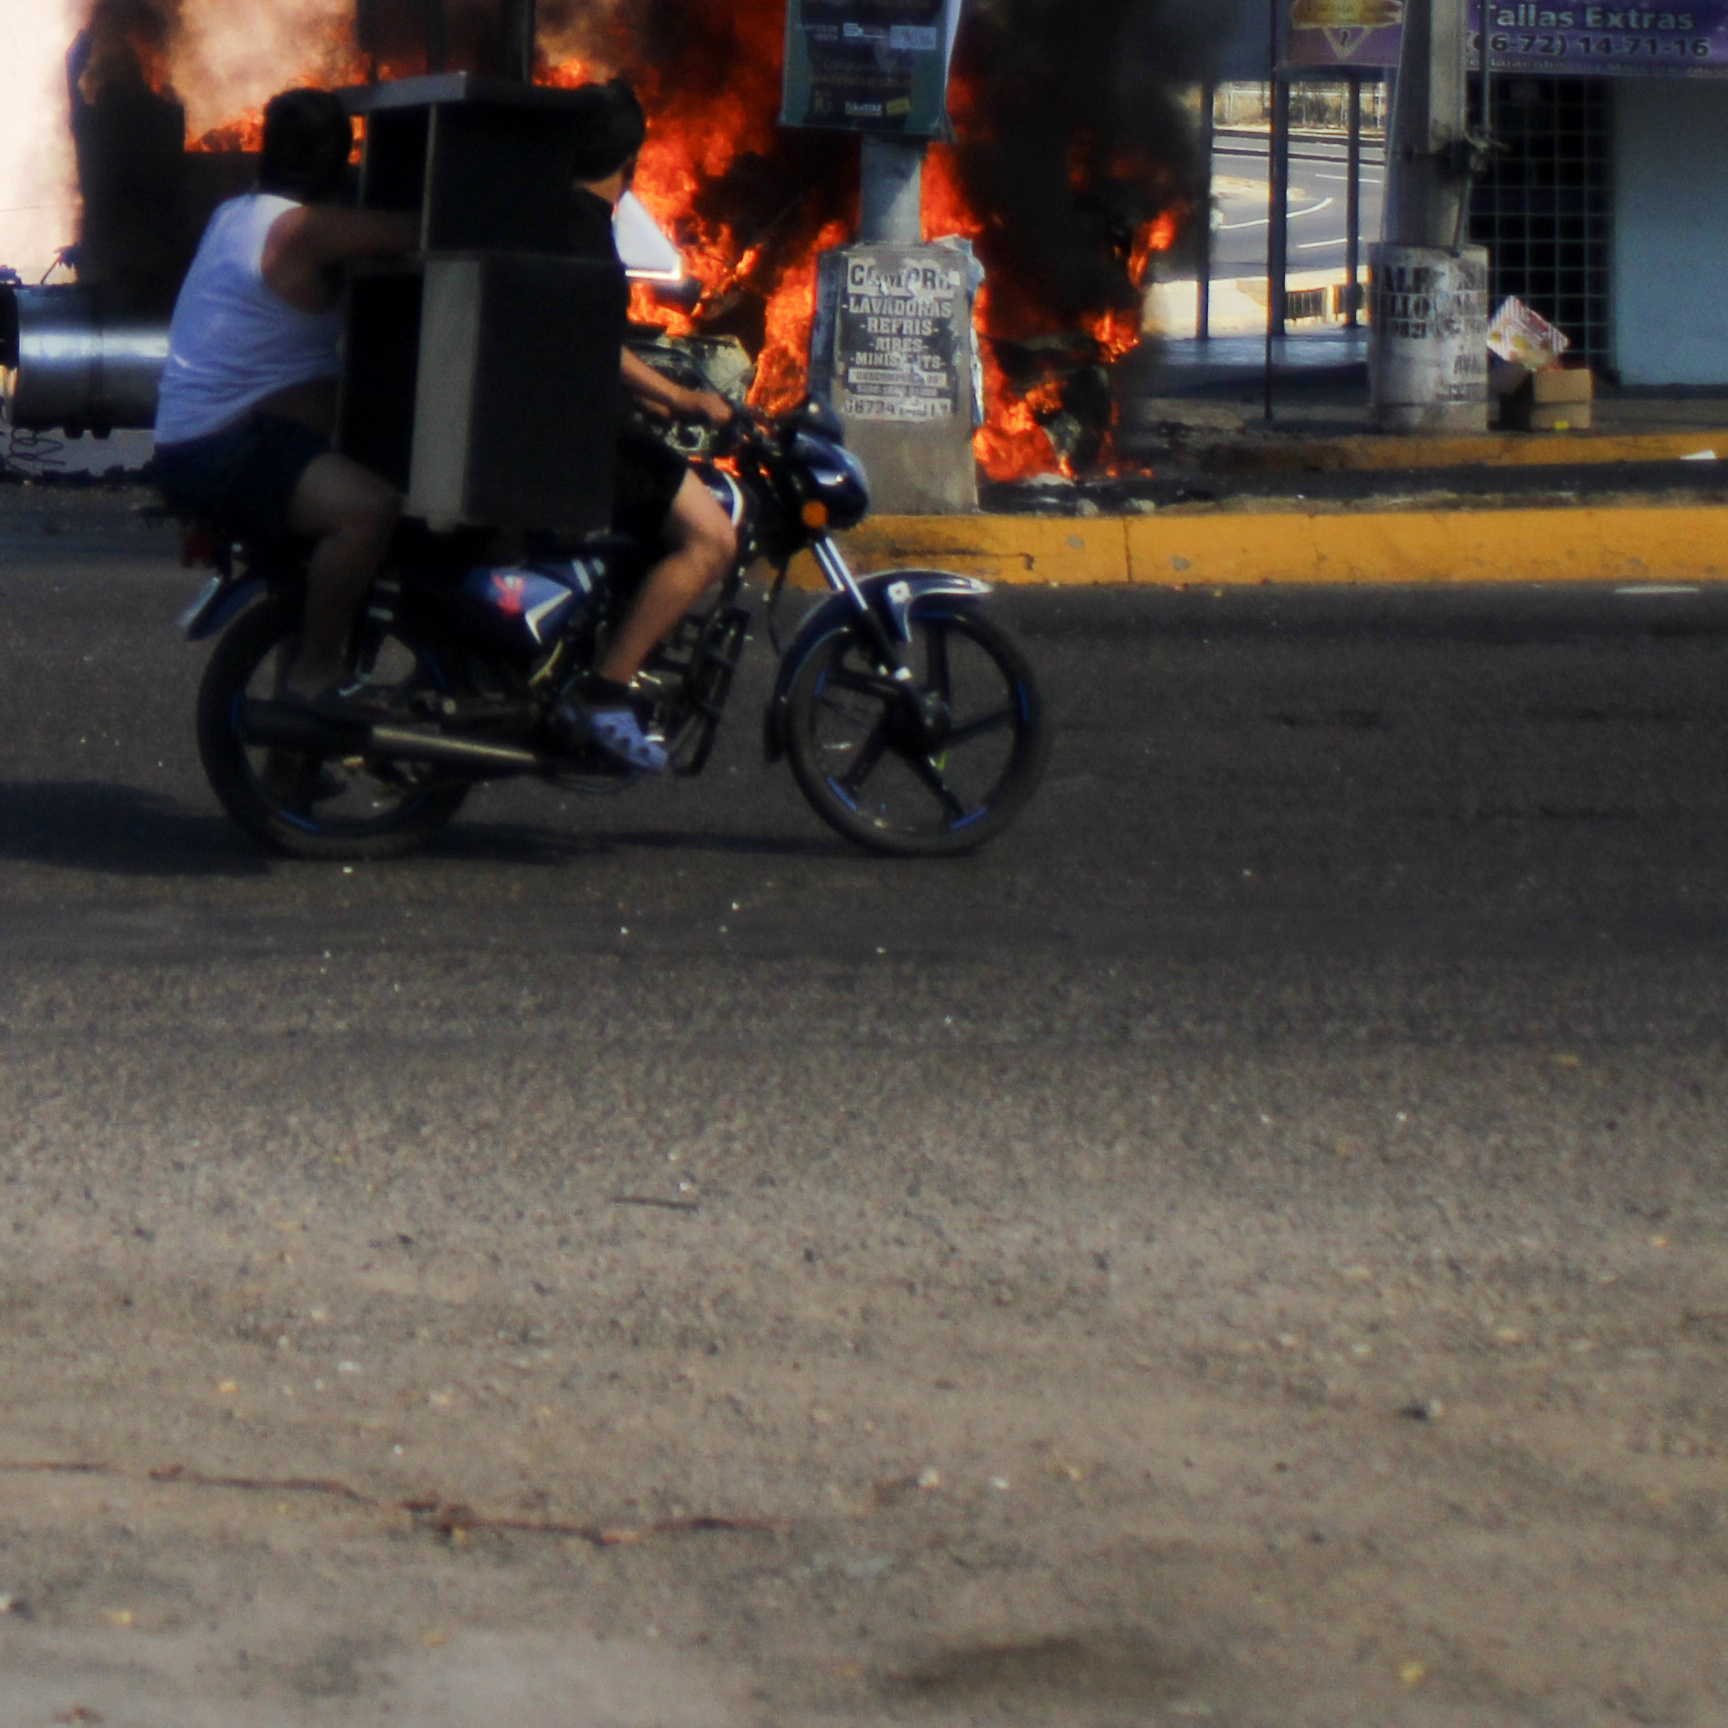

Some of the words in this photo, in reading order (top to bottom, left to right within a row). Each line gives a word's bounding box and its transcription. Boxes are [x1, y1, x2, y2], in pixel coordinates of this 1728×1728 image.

[1584, 6, 1695, 31] Extras
[1578, 35, 1711, 58] 14-71-16
[850, 352, 946, 368] -MINISTS-
